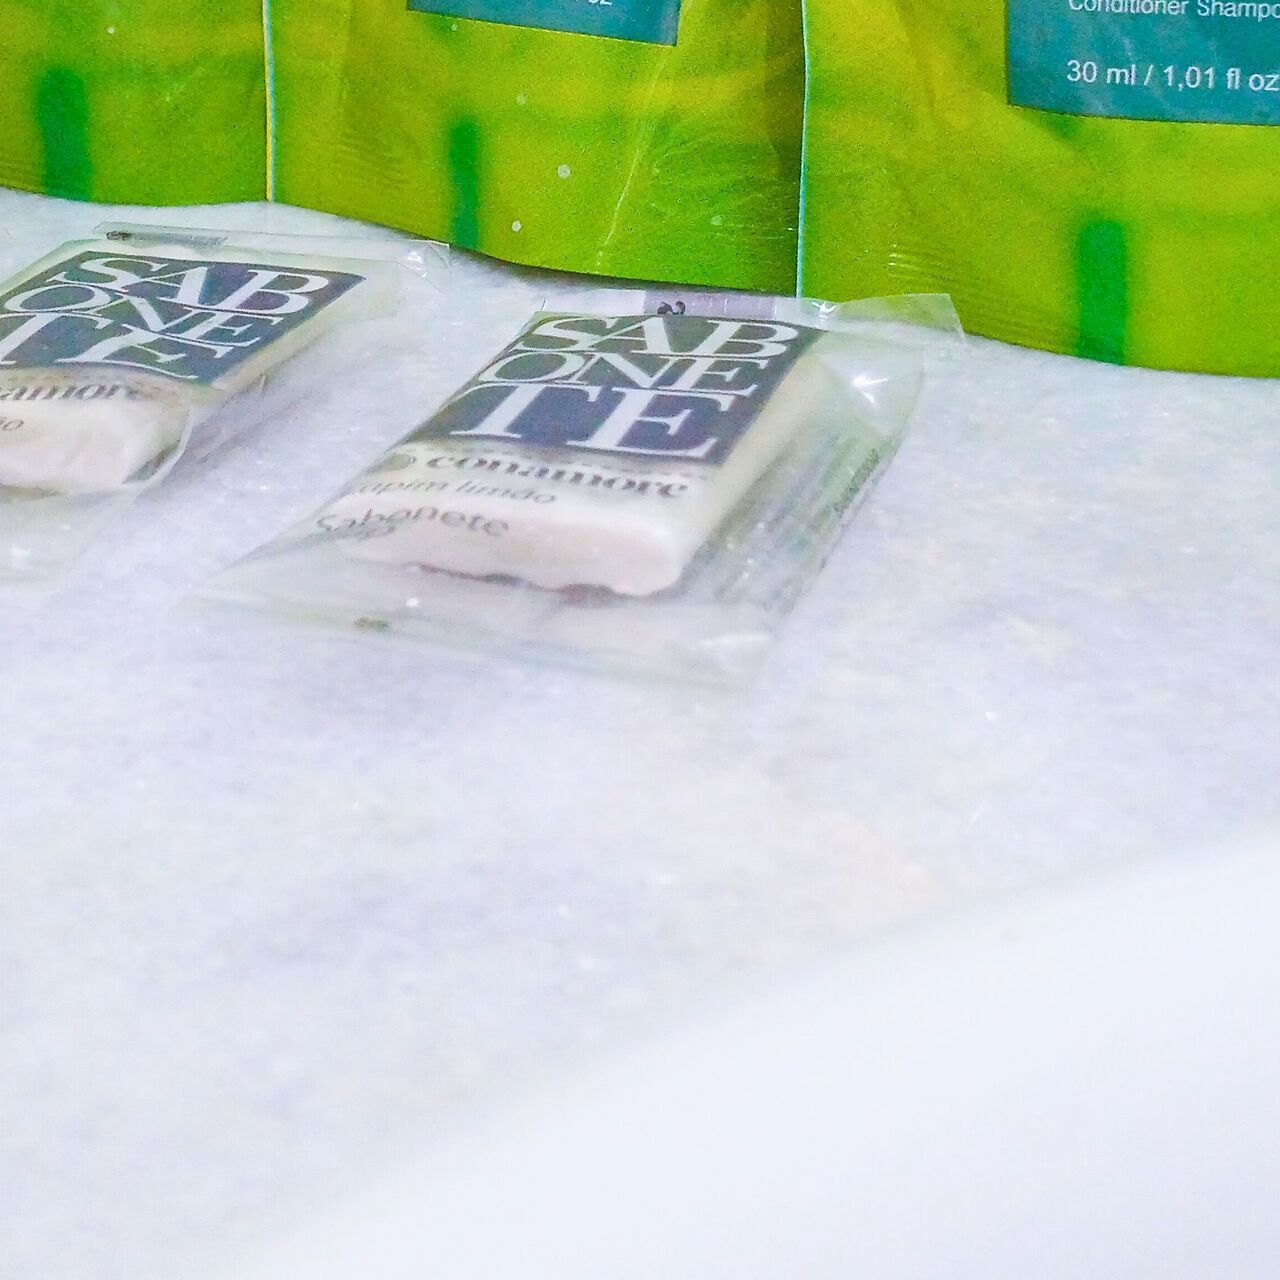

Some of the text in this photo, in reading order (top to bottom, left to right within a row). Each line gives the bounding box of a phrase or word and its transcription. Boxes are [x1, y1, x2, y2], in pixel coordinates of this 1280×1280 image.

[1067, 60, 1280, 92] 30 ml / 1,01 fl oz
[47, 257, 329, 315] SAB
[4, 284, 284, 348] ONE
[510, 317, 799, 359] SAB
[479, 352, 770, 398] ONE
[450, 383, 737, 459] TE
